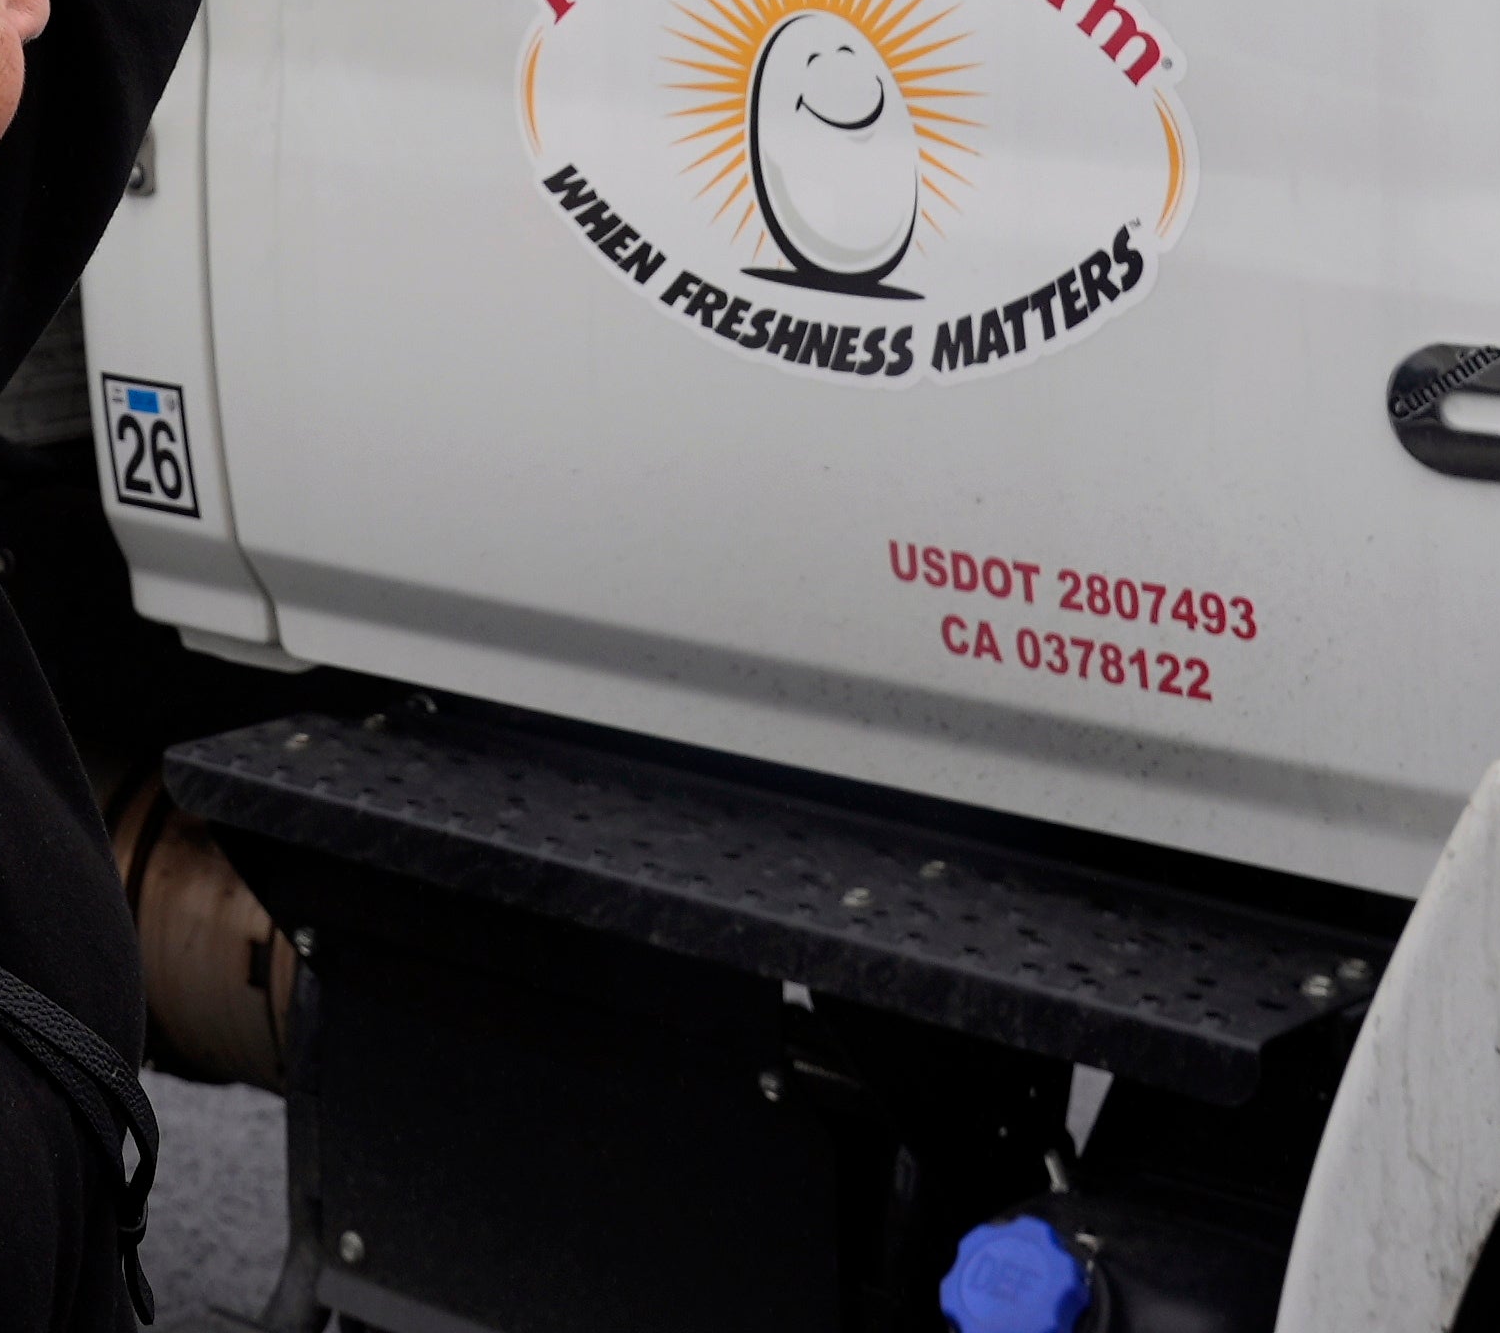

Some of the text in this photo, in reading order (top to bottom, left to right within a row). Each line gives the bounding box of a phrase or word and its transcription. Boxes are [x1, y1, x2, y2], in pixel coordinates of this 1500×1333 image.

[541, 163, 1146, 378] WHEN FRESHNESS MATTERS
[117, 413, 183, 500] 26
[888, 538, 1258, 640] USDOT 2807493
[940, 614, 1213, 702] CA 0378122
